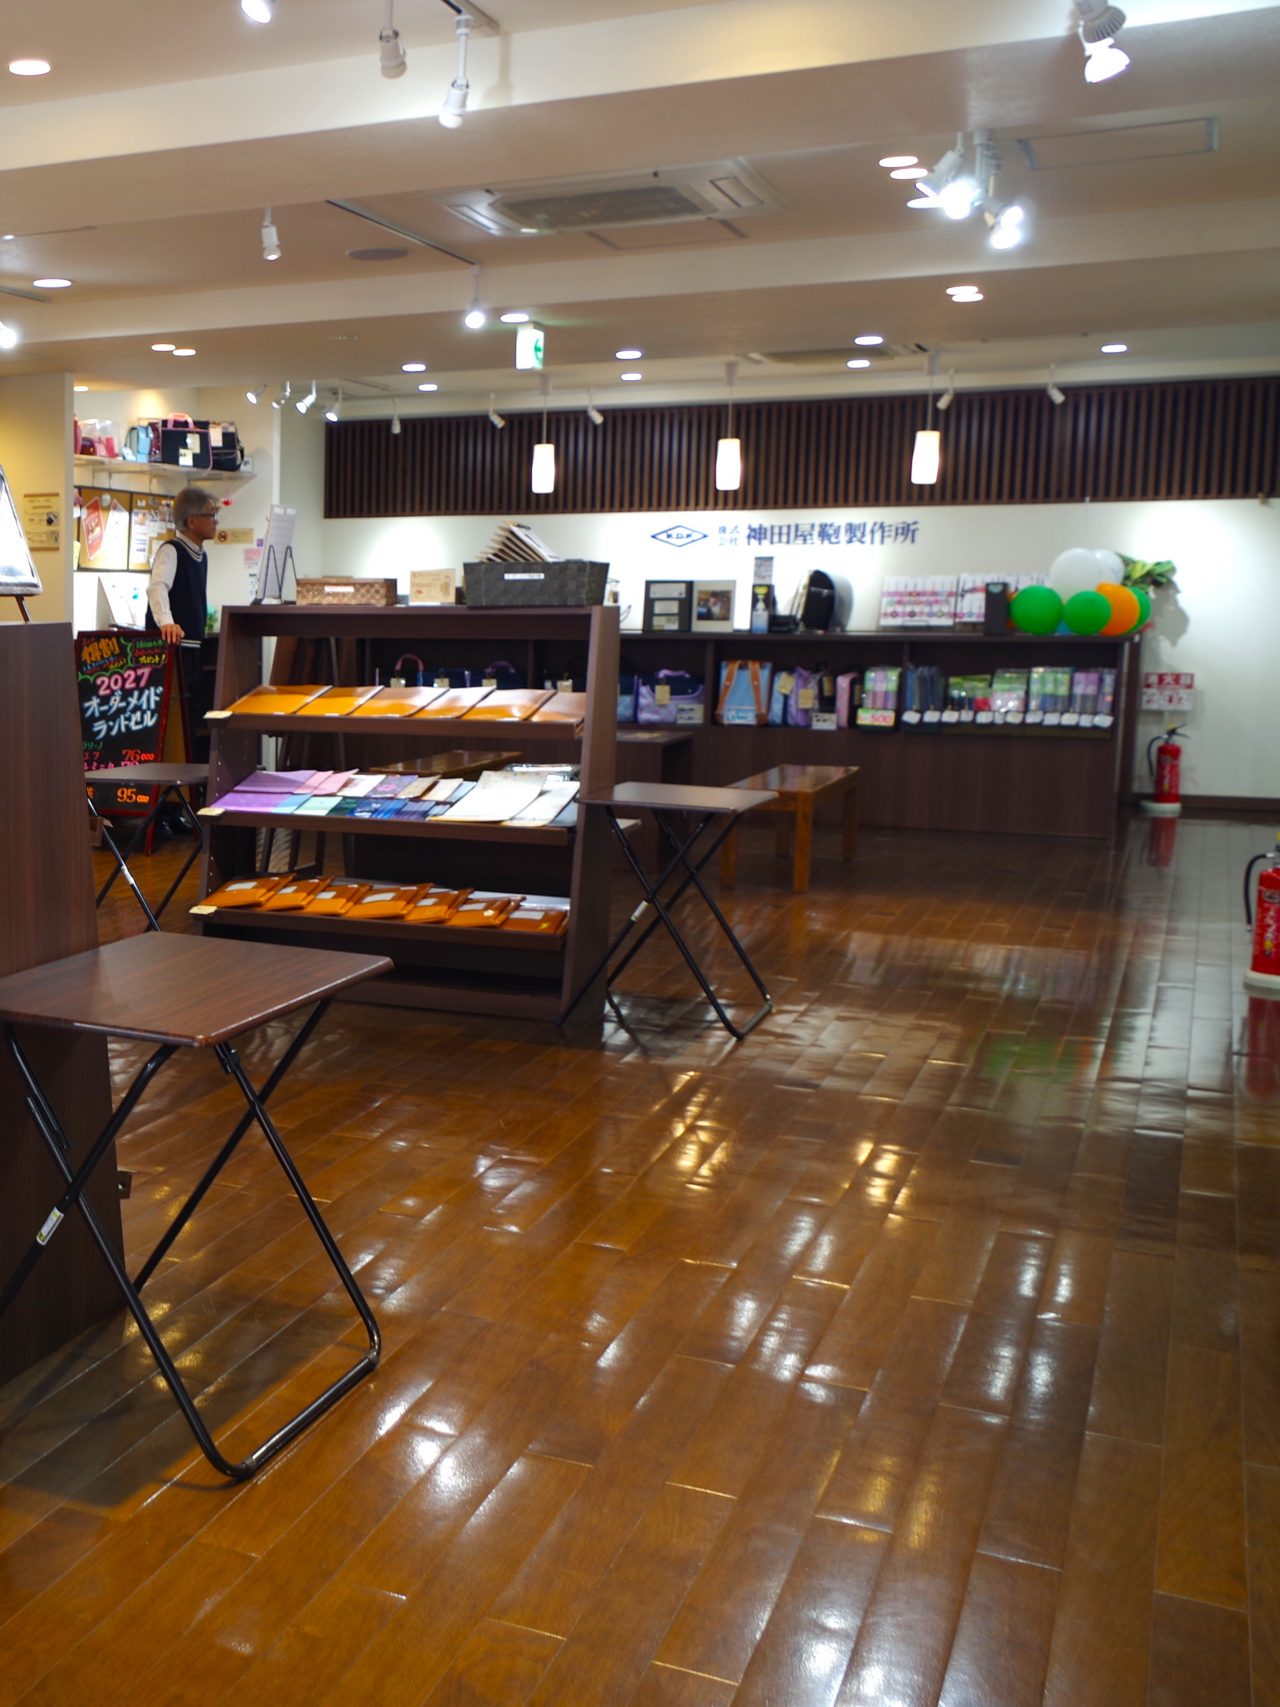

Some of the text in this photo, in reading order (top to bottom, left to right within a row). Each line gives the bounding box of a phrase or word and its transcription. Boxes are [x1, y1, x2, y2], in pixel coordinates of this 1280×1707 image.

[745, 521, 920, 546] 神田屋鞄製作所
[96, 667, 152, 696] 2027
[83, 686, 164, 718] オーダーメイド
[92, 710, 158, 740] ランドセル
